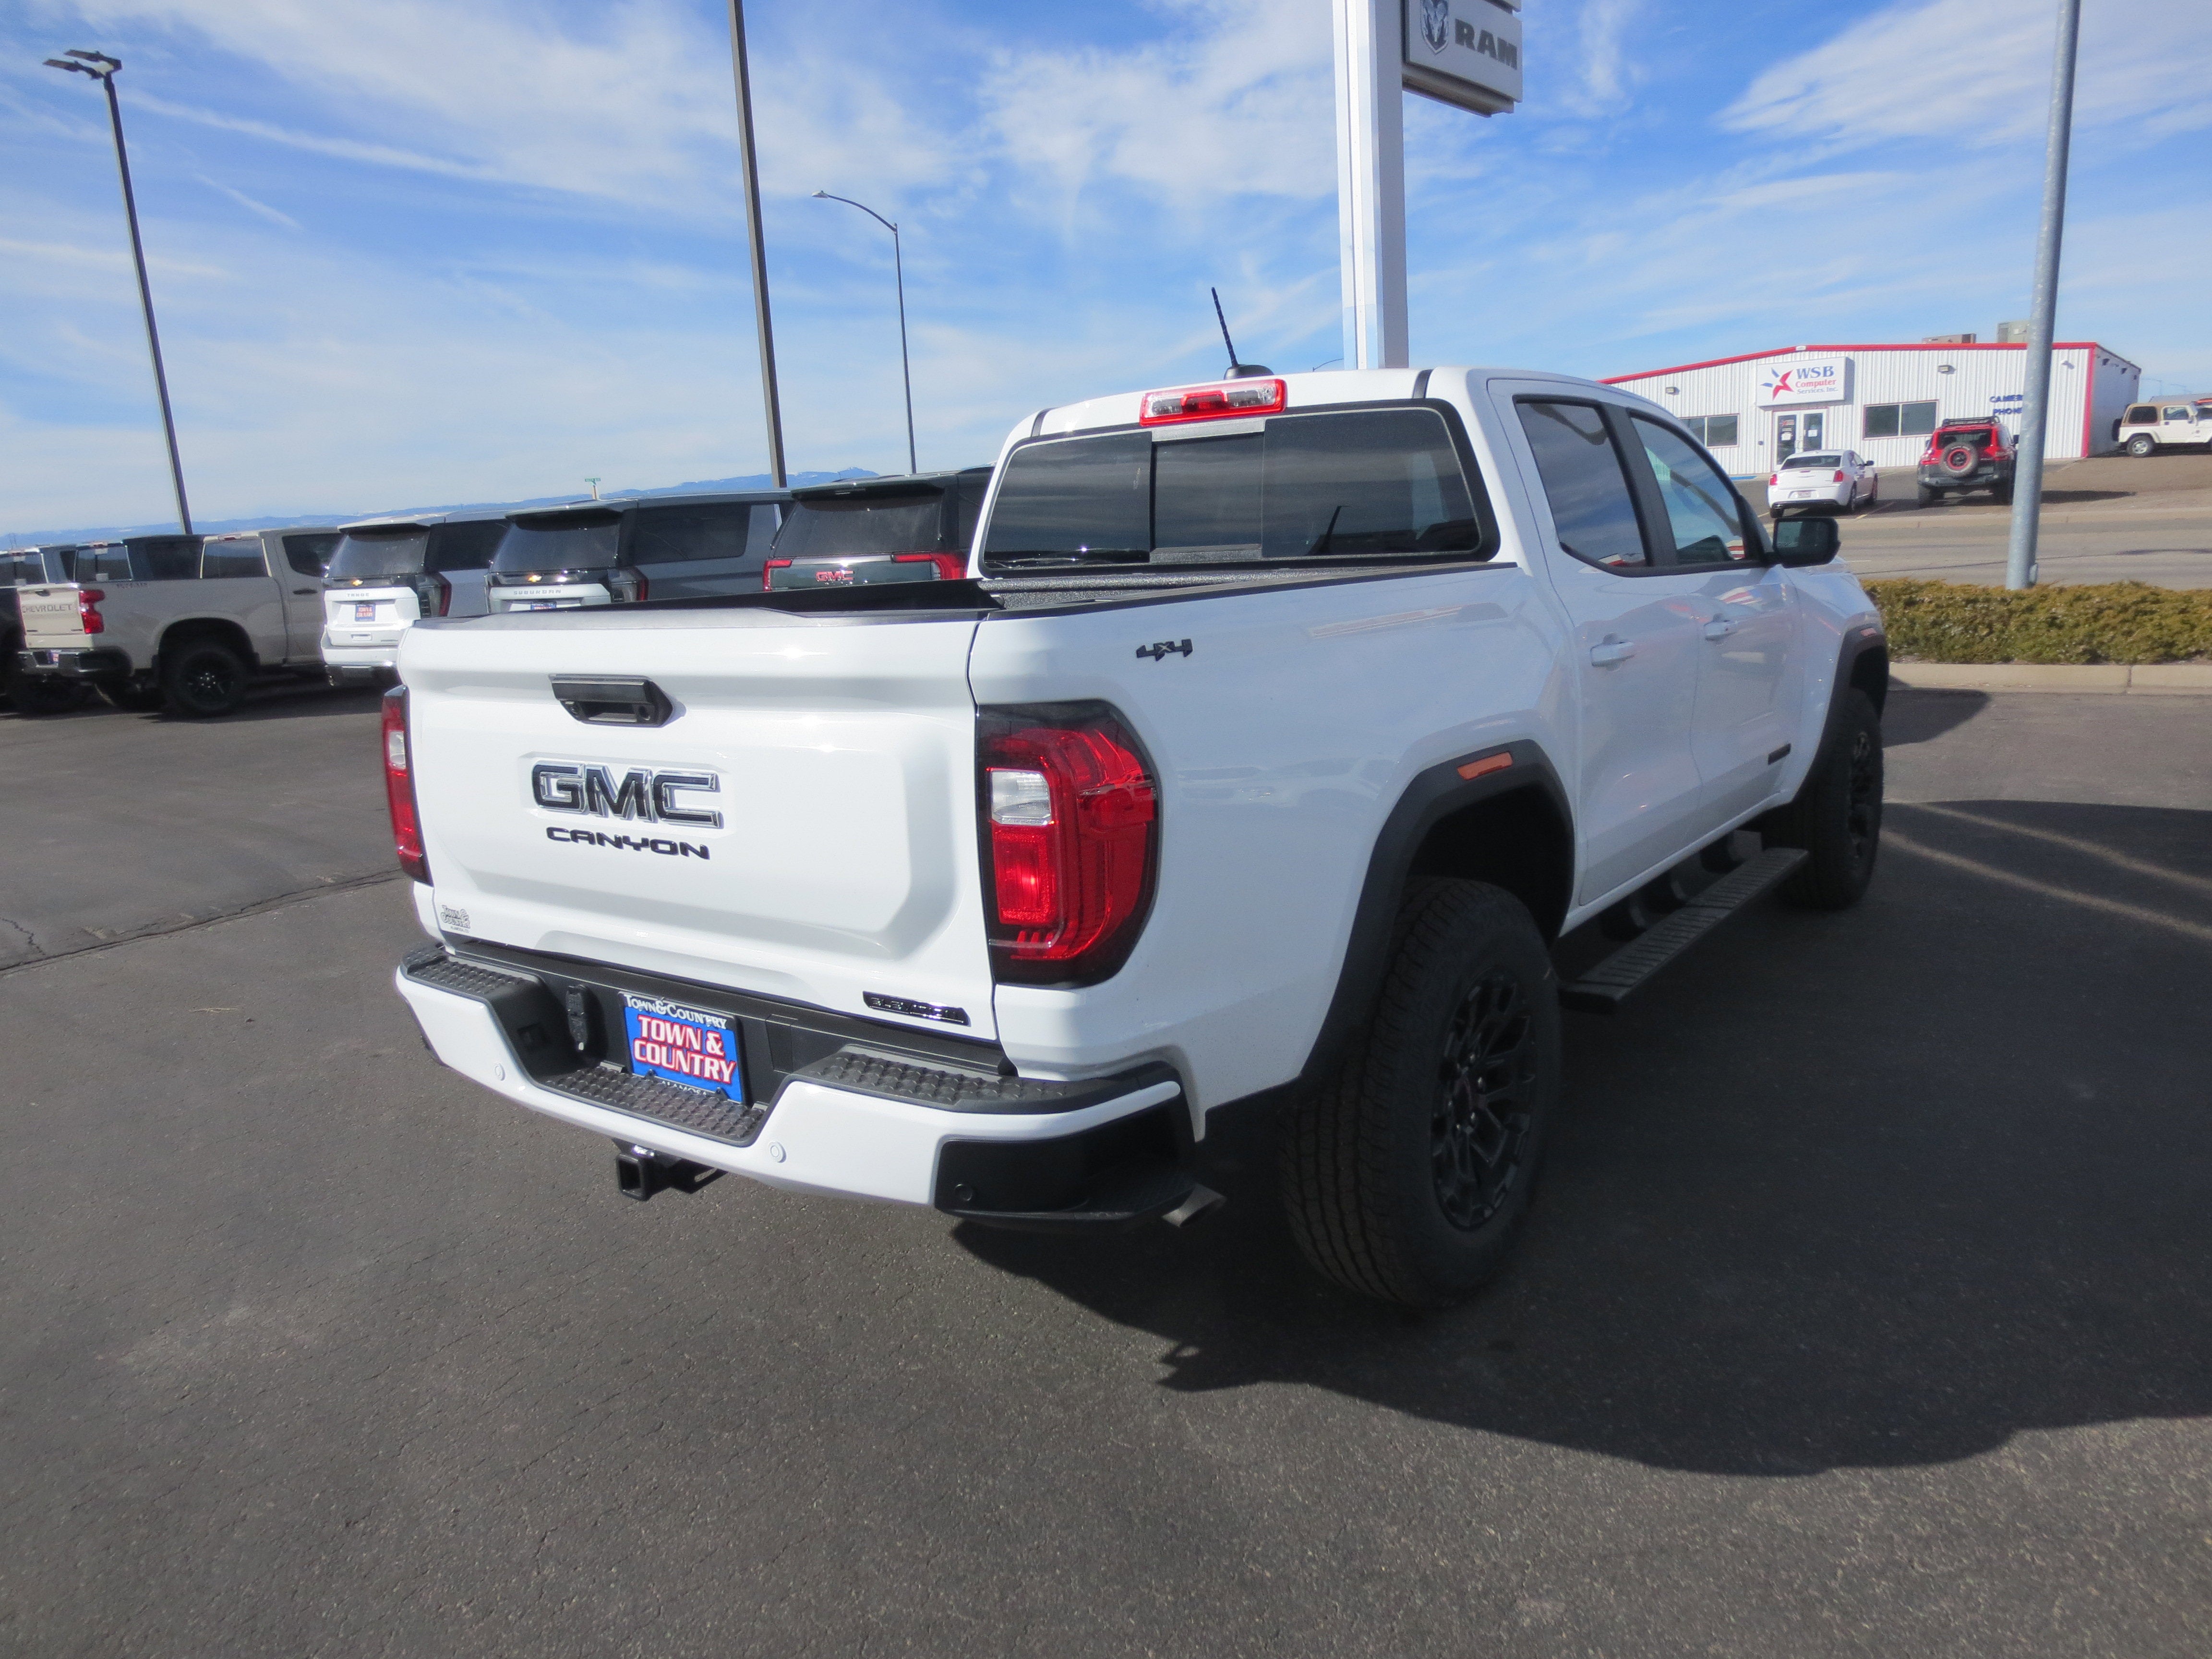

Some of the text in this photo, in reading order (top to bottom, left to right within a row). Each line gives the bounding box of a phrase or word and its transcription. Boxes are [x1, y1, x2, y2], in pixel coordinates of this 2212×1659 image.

[1455, 18, 1517, 70] RAM
[1795, 379, 1837, 388] Computer
[1796, 366, 1834, 379] WSB
[816, 570, 855, 582] GMC
[22, 603, 72, 613] CHEVROLET
[531, 760, 724, 829] GMC
[546, 827, 710, 860] CANYON
[637, 1014, 725, 1057] TOWN &
[633, 1038, 736, 1084] COUNTRY
